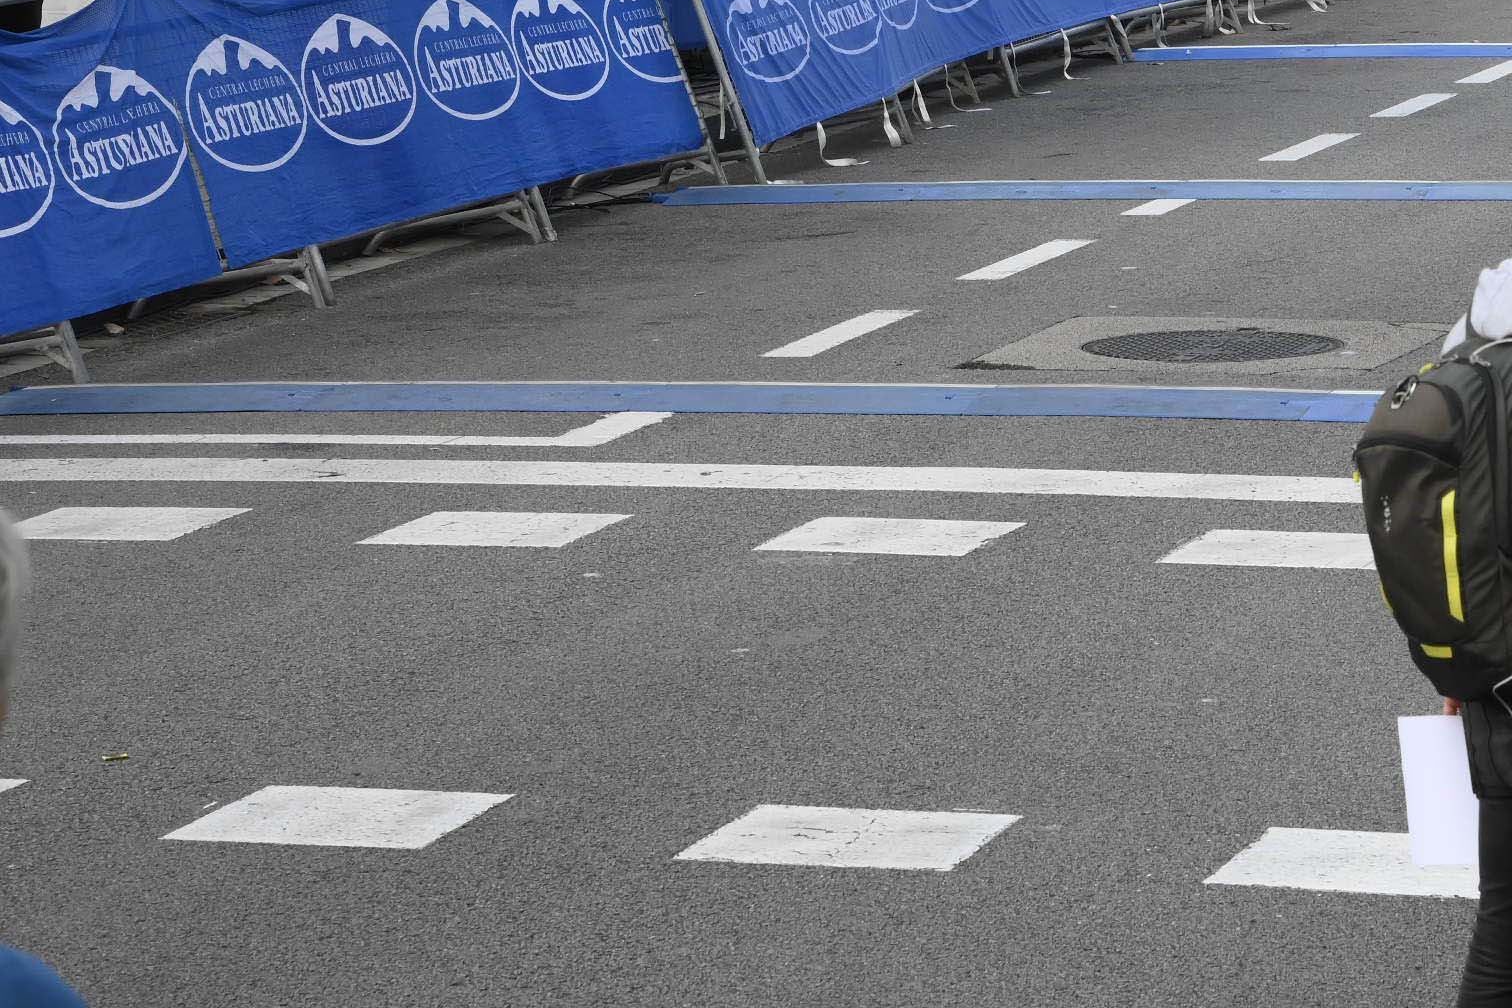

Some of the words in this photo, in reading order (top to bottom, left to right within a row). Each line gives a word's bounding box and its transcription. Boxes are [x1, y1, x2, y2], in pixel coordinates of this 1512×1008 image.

[434, 37, 467, 53] CENTRAL
[468, 32, 500, 48] LECHERA
[527, 23, 557, 38] CENTRAL
[558, 18, 588, 33] LECHERA
[323, 61, 357, 77] CENTRAL
[360, 51, 396, 69] LECHERA
[424, 45, 516, 93] ASTURIANA
[520, 30, 605, 76] ASTURIANA
[208, 82, 248, 99] CENTRAL
[250, 75, 286, 93] LECHERA
[312, 69, 412, 120] ASTURIANA
[198, 92, 302, 144] ASTURIANA
